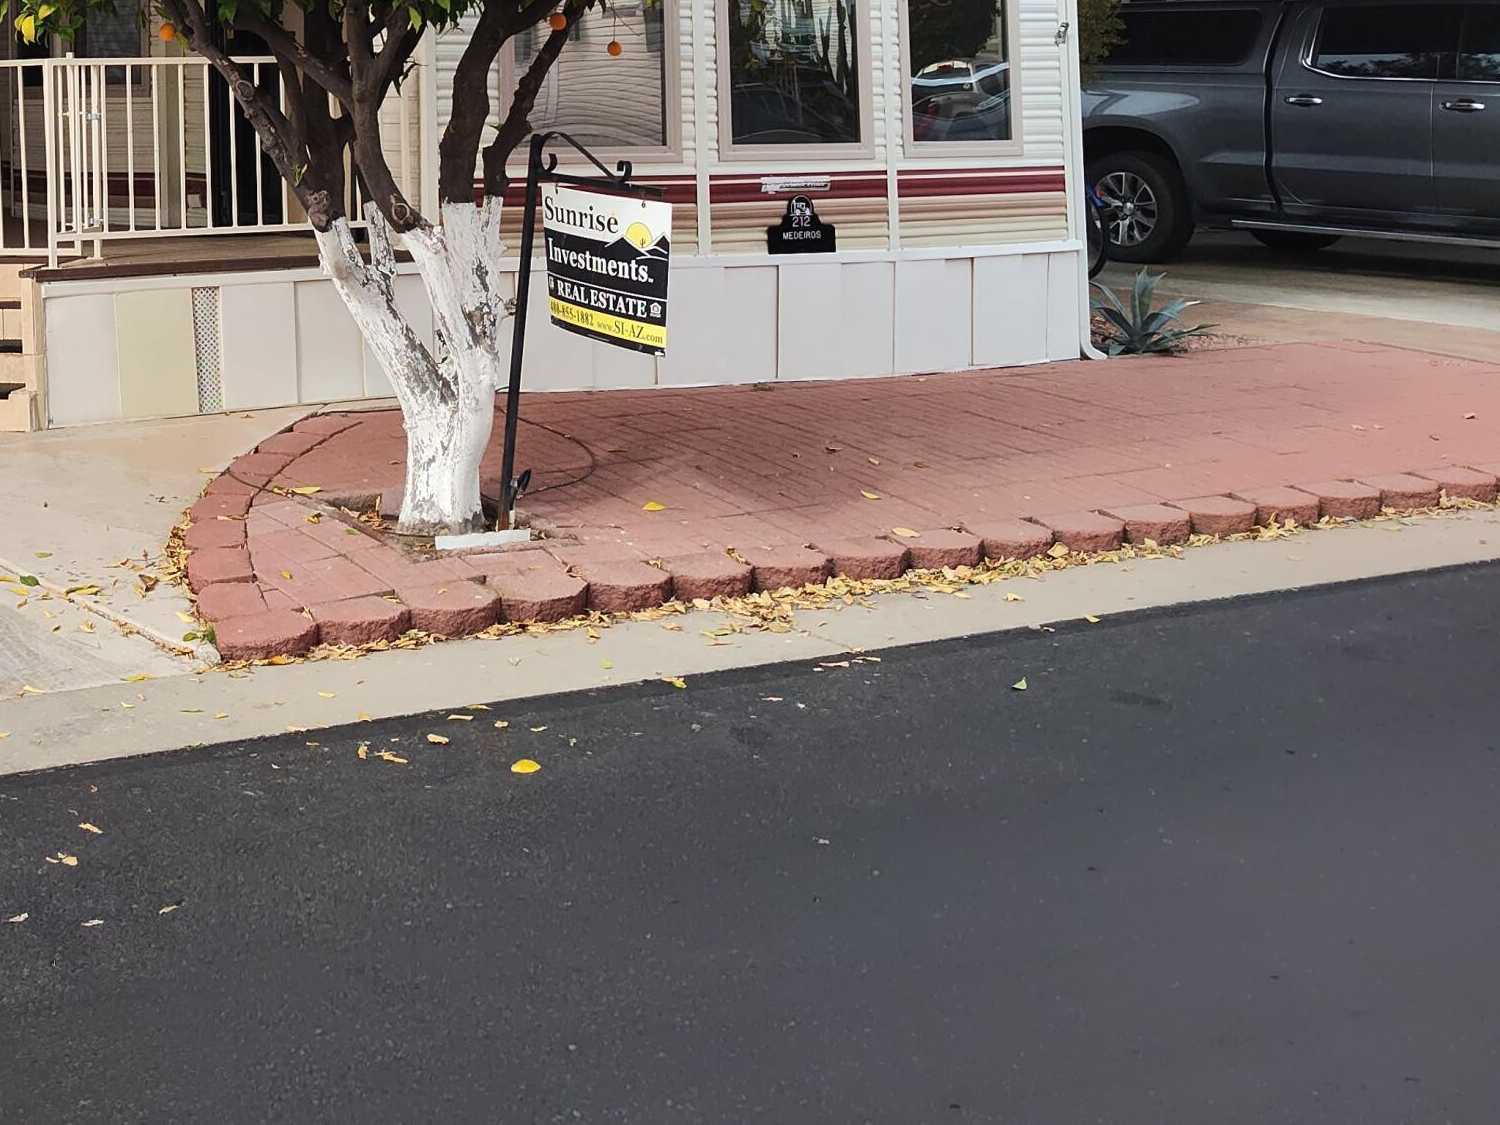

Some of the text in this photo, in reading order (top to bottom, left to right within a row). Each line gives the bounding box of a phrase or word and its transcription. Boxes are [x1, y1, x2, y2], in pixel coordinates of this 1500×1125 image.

[544, 195, 619, 234] Sunrise
[792, 216, 811, 228] 212
[782, 230, 822, 241] MEDEIROS
[557, 279, 648, 318] REAL ESTATE
